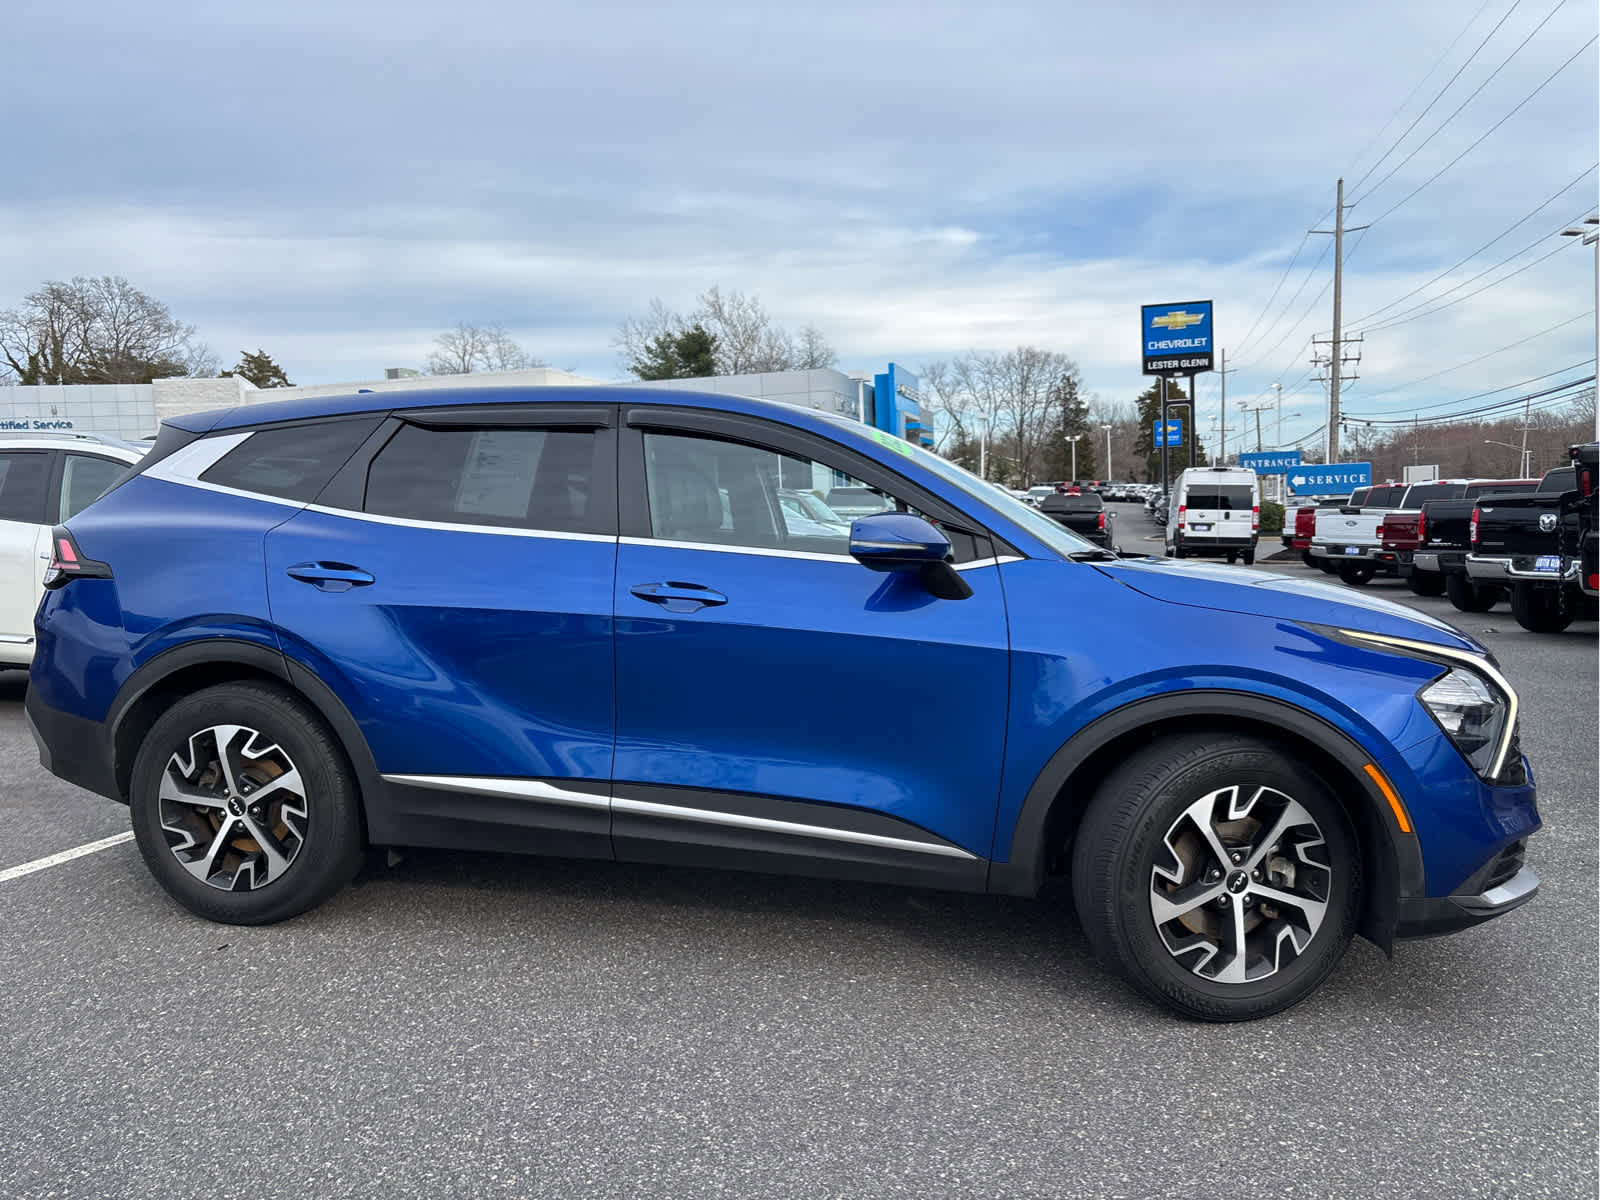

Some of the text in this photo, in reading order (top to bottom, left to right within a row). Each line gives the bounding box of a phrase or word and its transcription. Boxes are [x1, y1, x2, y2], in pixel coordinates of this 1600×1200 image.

[1148, 337, 1208, 350] CHEVROLET
[1147, 358, 1209, 370] LESTER GLENN
[0, 420, 73, 430] tified Service
[1243, 458, 1298, 469] ENTRANCE
[1308, 473, 1367, 486] SERVICE
